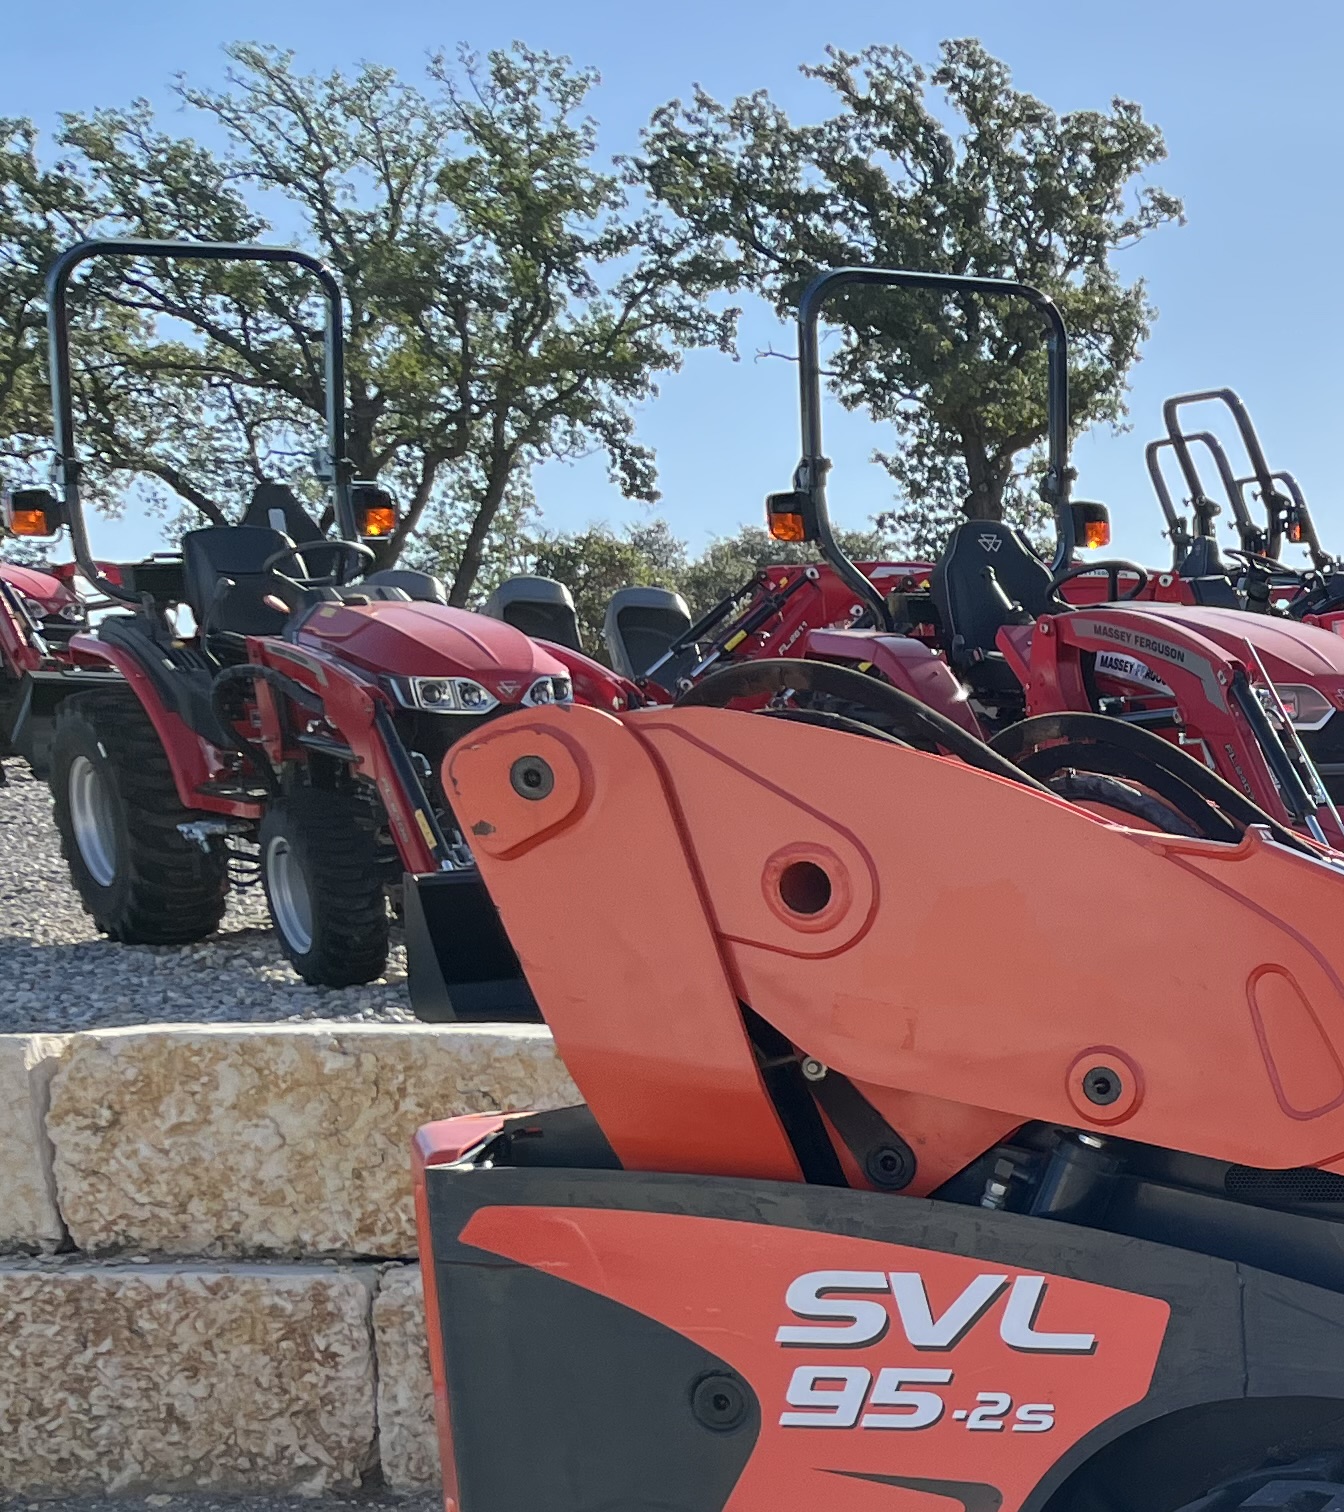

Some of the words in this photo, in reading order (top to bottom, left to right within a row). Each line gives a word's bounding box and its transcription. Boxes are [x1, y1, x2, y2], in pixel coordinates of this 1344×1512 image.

[1093, 624, 1132, 642] MASSEY
[1134, 635, 1185, 663] FERGUSON
[1100, 655, 1135, 674] MASSEY
[775, 1270, 1098, 1354] SVL
